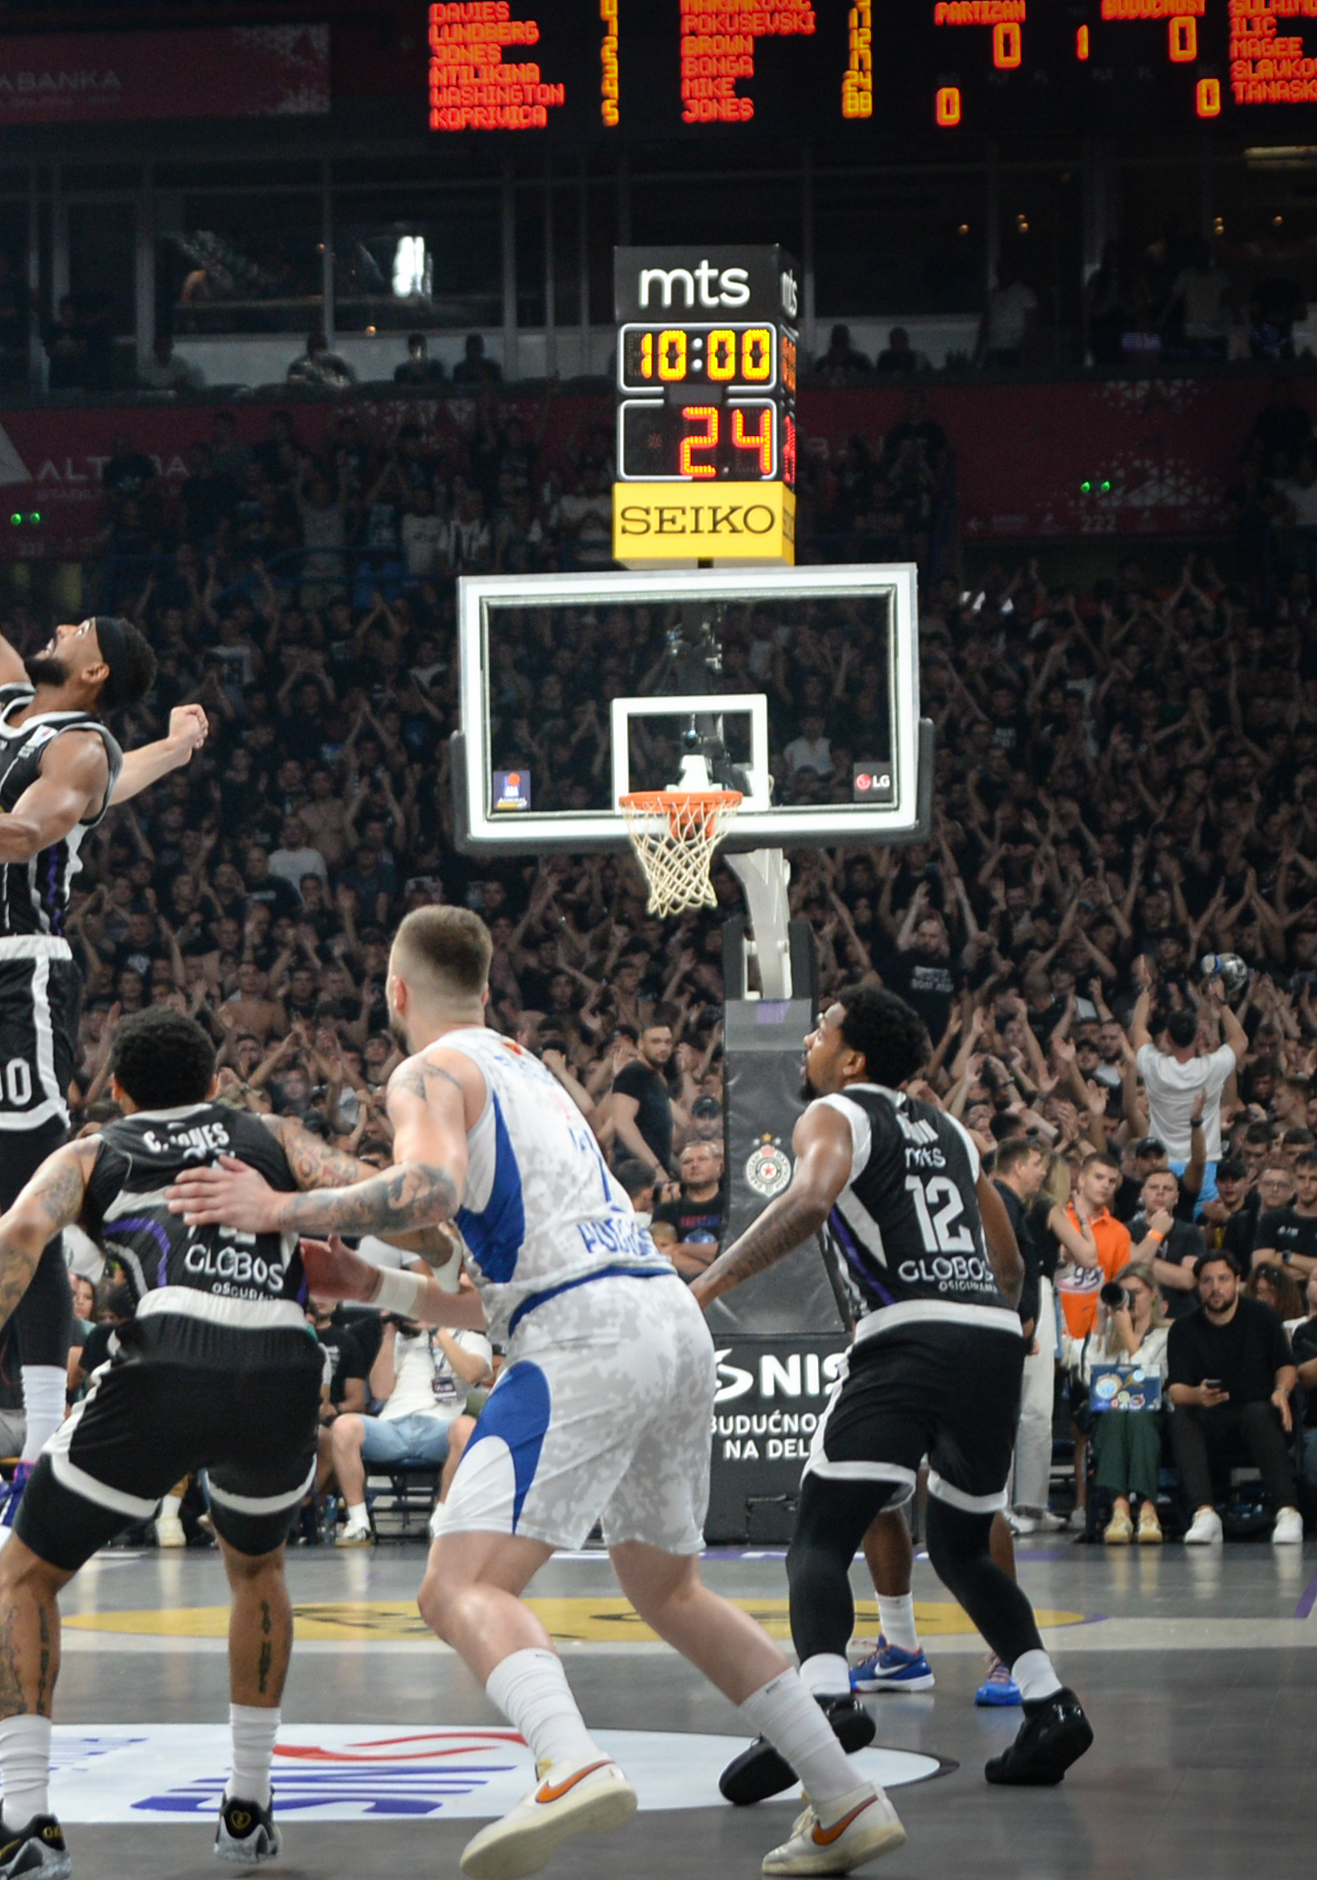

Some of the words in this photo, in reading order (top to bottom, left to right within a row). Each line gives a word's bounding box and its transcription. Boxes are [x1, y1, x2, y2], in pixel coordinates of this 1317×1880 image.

[429, 1, 510, 23] DAVIES
[935, 0, 1026, 25] PARTIZAN
[429, 21, 539, 46] LUNDBERG
[1169, 16, 1197, 62] 0
[1230, 16, 1277, 39] ILIC
[430, 43, 501, 66] JONES
[682, 34, 754, 57] BROWN
[993, 22, 1021, 69] 0
[1077, 24, 1089, 60] 1
[1230, 37, 1303, 60] MAGEE
[429, 63, 540, 86] NTILIKINA
[682, 55, 754, 79] BONGA
[1231, 58, 1317, 80] SLAVKO
[430, 83, 565, 107] WASHINGTON
[682, 76, 735, 100] MIKE
[1197, 79, 1221, 118] 0
[430, 105, 547, 130] KOPRIVICA
[682, 97, 754, 123] JONES
[842, 91, 872, 118] 88
[937, 87, 960, 126] 0
[640, 259, 751, 309] mts
[641, 329, 770, 381] 10:00
[679, 407, 772, 478] 24
[620, 505, 775, 534] SEIKO
[872, 774, 890, 788] LG
[6, 1057, 32, 1106] 0
[905, 1174, 975, 1252] 12
[186, 1244, 284, 1291] GLOBOS
[898, 1257, 994, 1282] GLOBOS
[724, 1438, 759, 1459] NA
[768, 1438, 811, 1458] DEL
